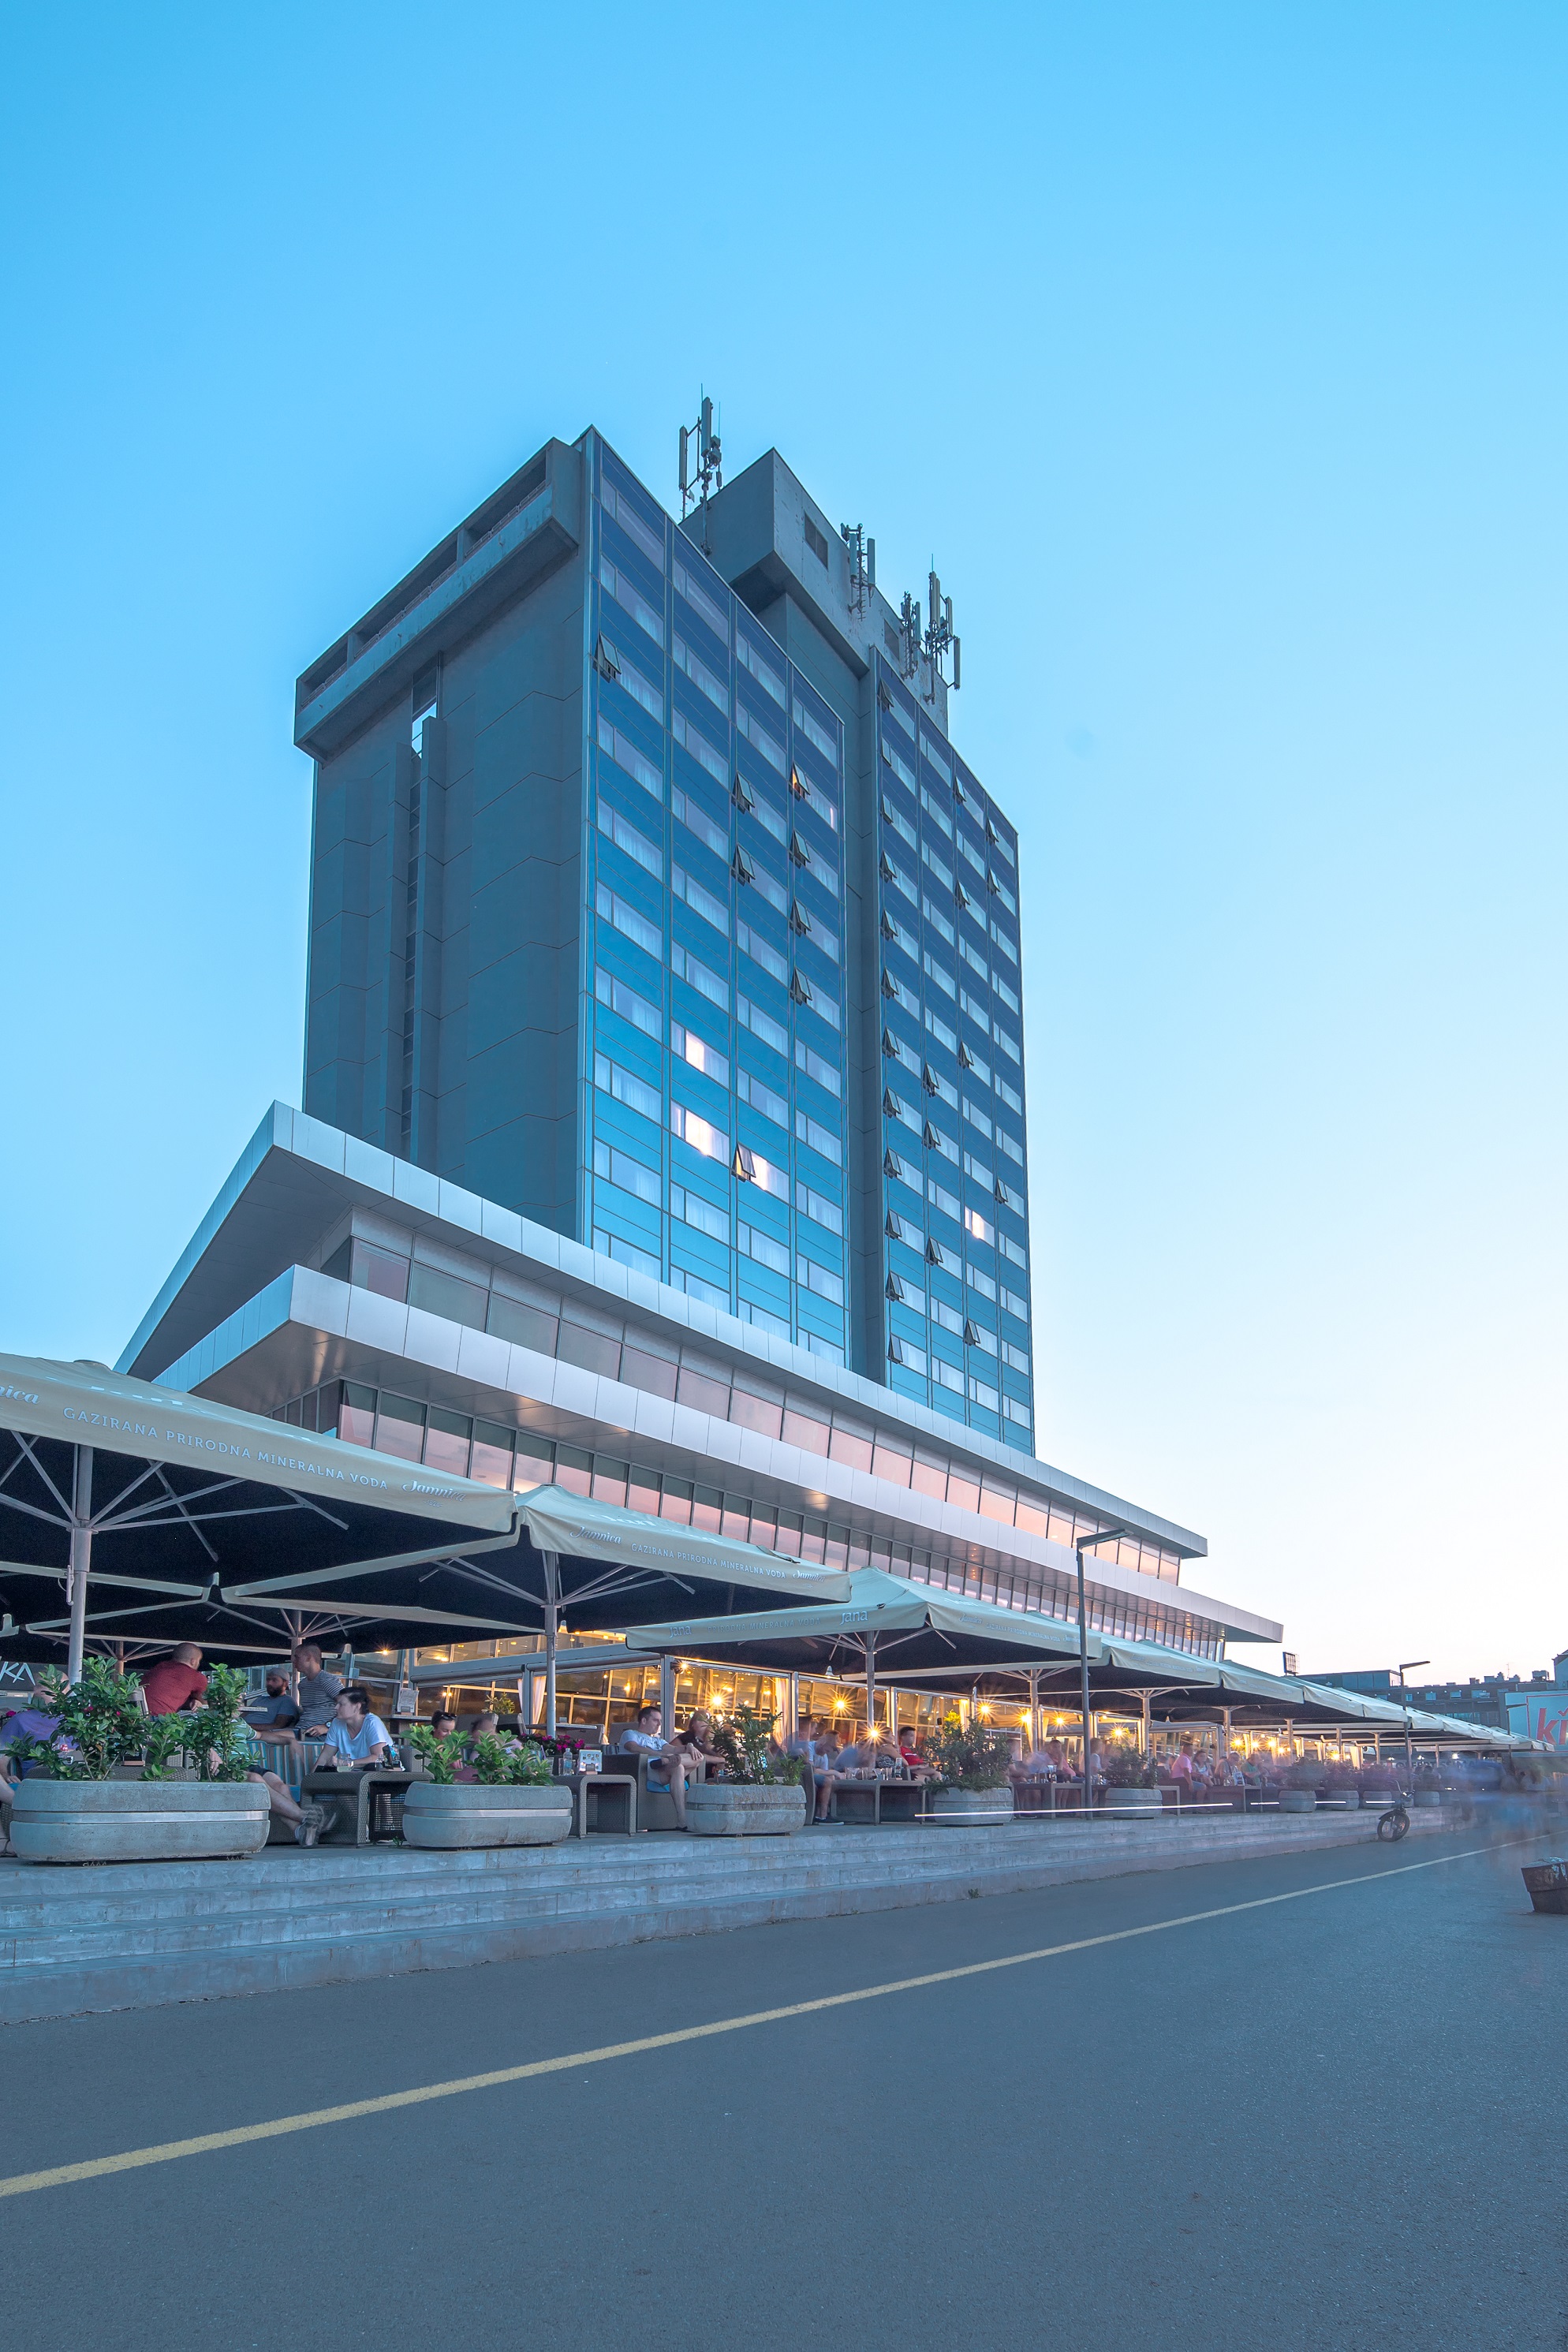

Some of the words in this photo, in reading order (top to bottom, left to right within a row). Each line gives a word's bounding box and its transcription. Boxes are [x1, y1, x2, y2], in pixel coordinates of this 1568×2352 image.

[63, 1407, 158, 1438] GAZIRANA
[166, 1430, 250, 1458] PRIRODNA
[257, 1450, 345, 1480] MINERALNA
[349, 1473, 387, 1489] VODA
[401, 1480, 466, 1502] Jamnica
[569, 1525, 622, 1544] Jamnica
[631, 1543, 674, 1559] GAZIRANA
[678, 1552, 718, 1566] PRIRODNA
[720, 1559, 763, 1575] MINERALNA
[766, 1569, 786, 1579] VODA
[707, 1623, 746, 1633] PRIRODNA
[749, 1619, 795, 1630] MINERALNA
[798, 1617, 821, 1626] VODA
